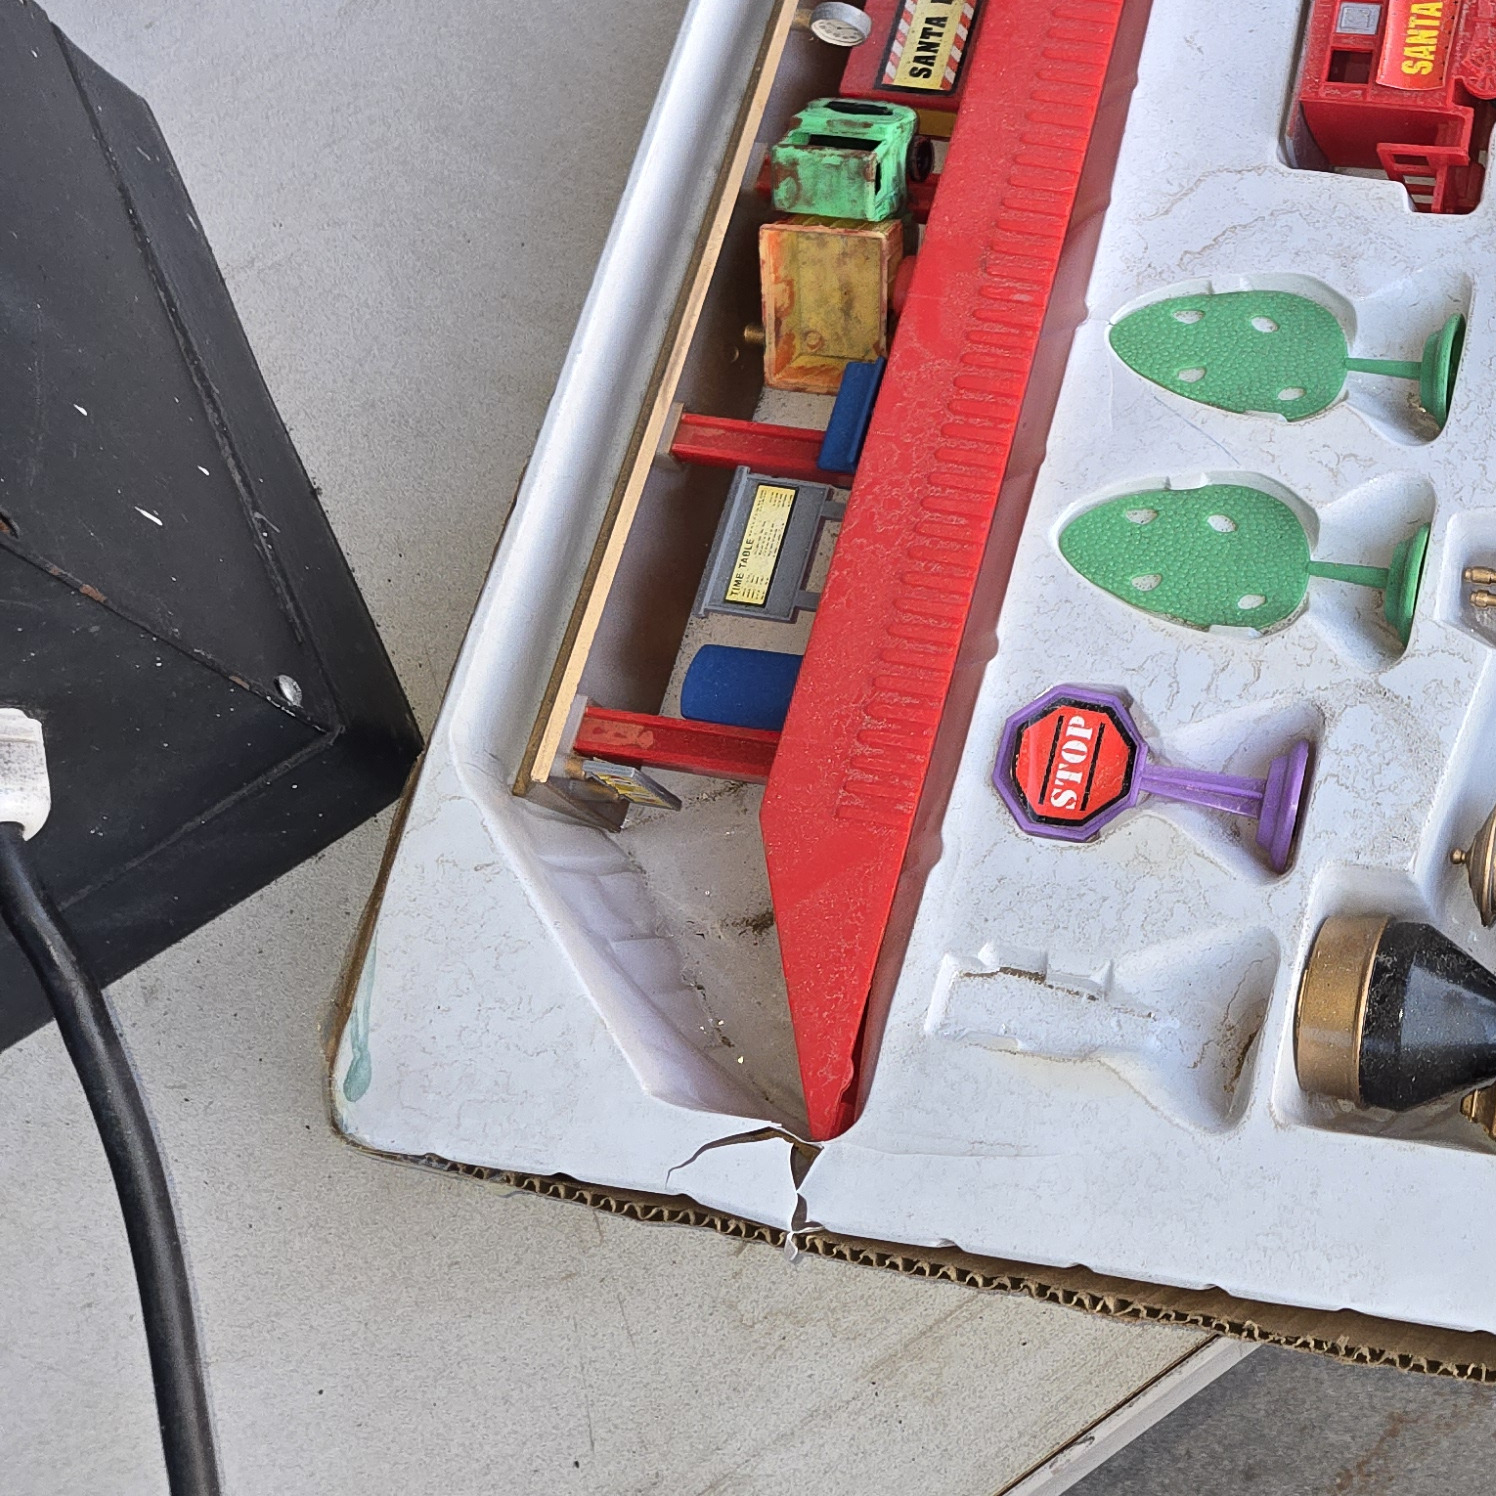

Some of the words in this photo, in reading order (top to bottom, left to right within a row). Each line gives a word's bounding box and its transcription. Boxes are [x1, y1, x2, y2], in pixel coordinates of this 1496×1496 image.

[909, 16, 949, 79] SANTA
[1401, 1, 1444, 76] SANTA
[729, 572, 744, 597] TIME
[738, 538, 755, 569] TABLE
[1050, 715, 1093, 810] STOP
